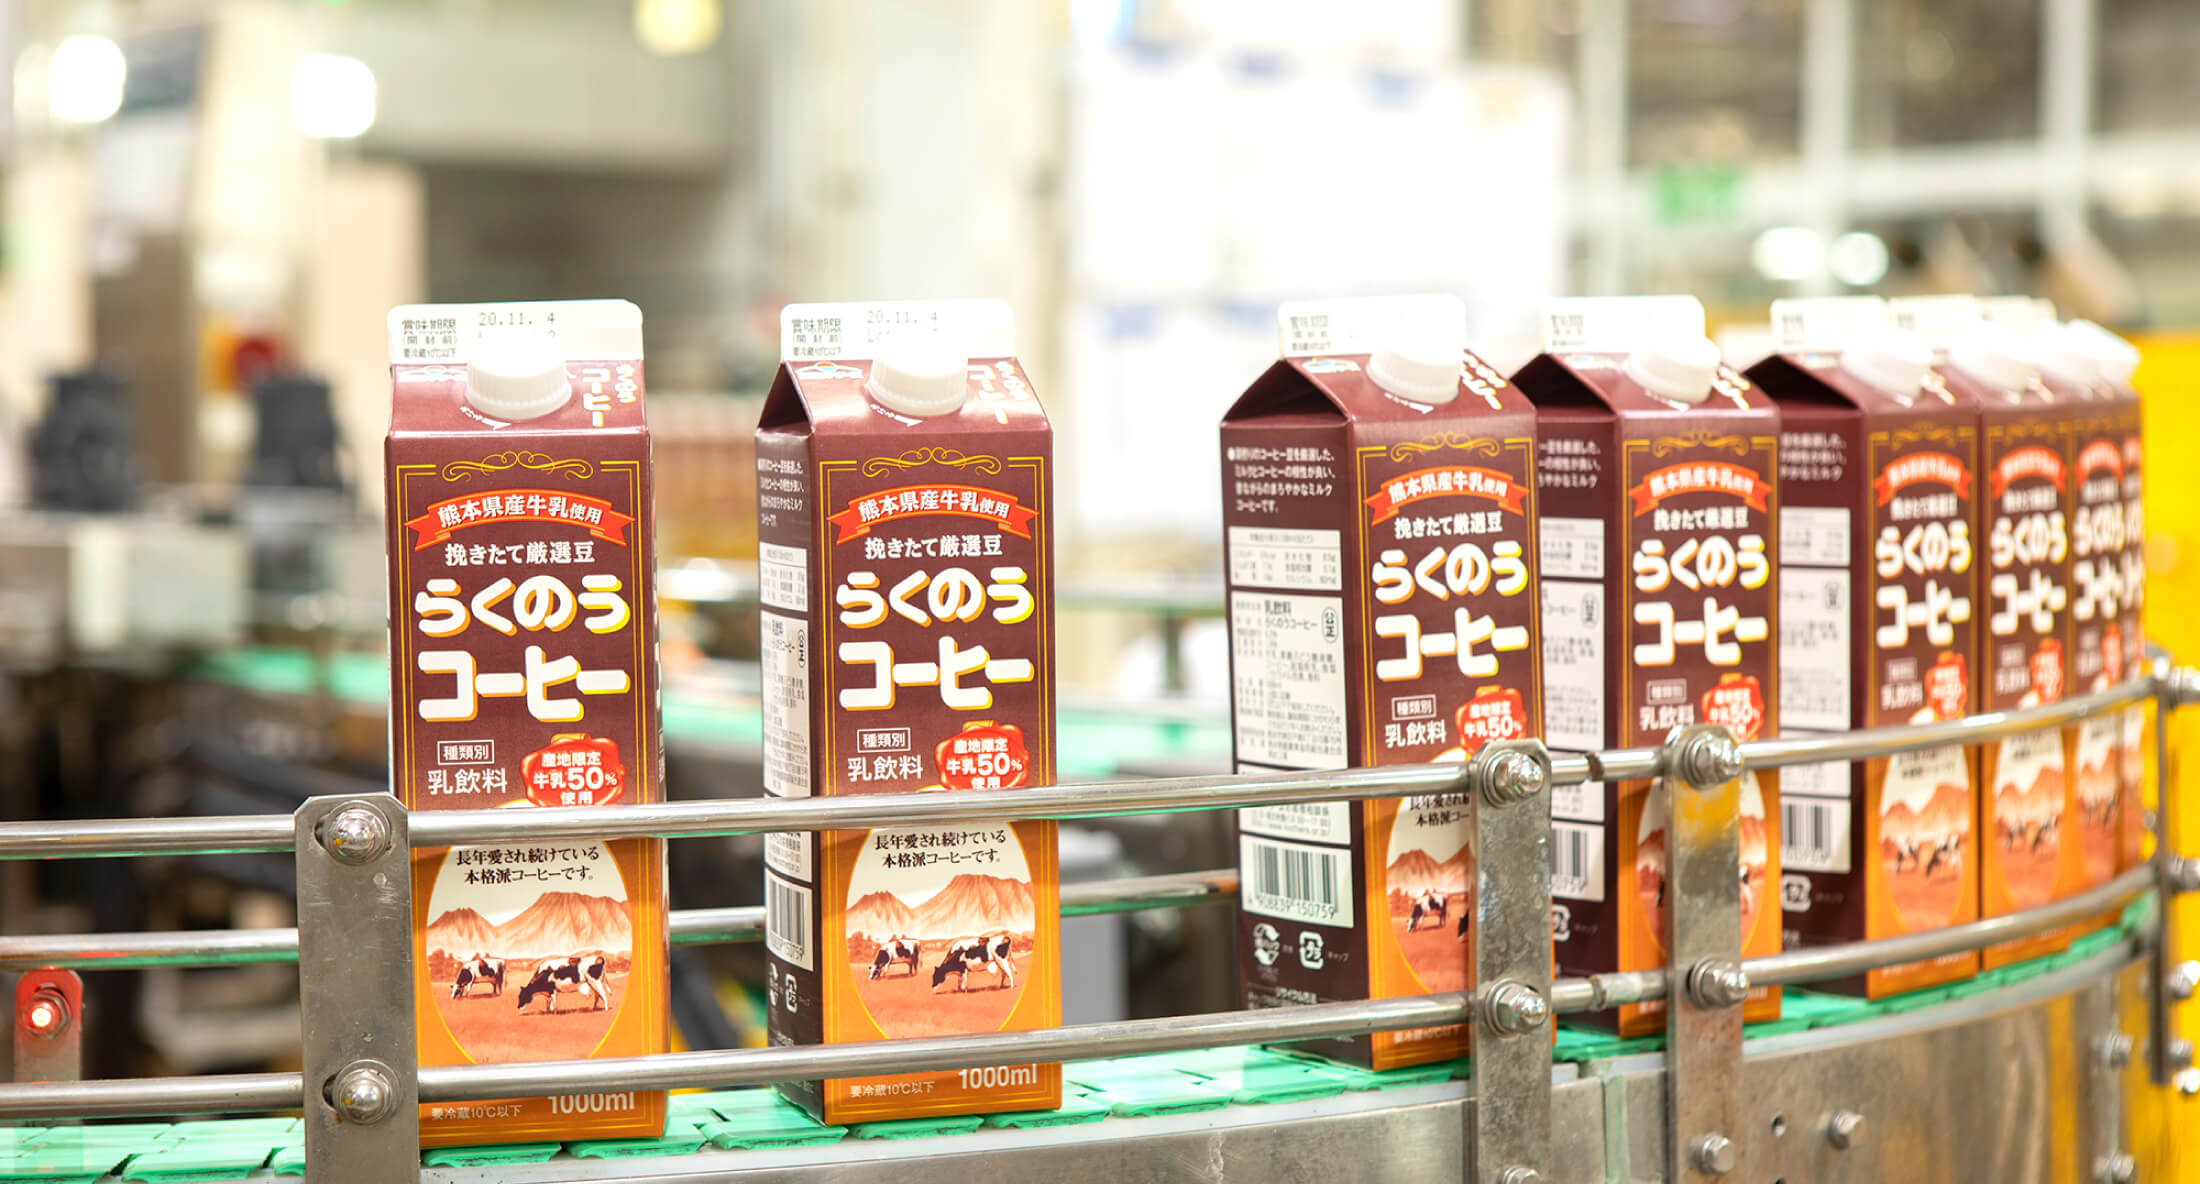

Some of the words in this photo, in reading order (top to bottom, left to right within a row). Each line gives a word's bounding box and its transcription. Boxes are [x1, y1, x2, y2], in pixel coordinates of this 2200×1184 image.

[479, 312, 532, 327] 20.11.
[547, 312, 556, 323] 4
[867, 310, 918, 324] 20.11.
[930, 311, 938, 322] 4
[582, 368, 611, 427] コーヒー
[1388, 471, 1507, 504] 熊本県産牛乳使用
[437, 495, 603, 528] 熊本県産牛乳使用
[858, 489, 1010, 522] 熊本県産牛乳使用
[1394, 510, 1503, 539] 挽きたて厳選豆
[865, 534, 1003, 560] 挽きたて厳選豆
[1875, 520, 1972, 578] らくのう
[1990, 511, 2067, 568] らくのう
[445, 541, 595, 567] 挽きたて厳選豆
[1633, 534, 1769, 592] らくのう
[1372, 540, 1528, 605] らくのう
[414, 574, 631, 637] らくのう
[836, 567, 1035, 628] らくのう
[1991, 568, 2067, 635] コーヒー
[1876, 579, 1971, 649] コーヒー
[1375, 607, 1529, 682] コーヒー
[1634, 596, 1768, 667] コーヒー
[418, 645, 631, 722] コーヒー
[838, 635, 1035, 711] コーヒー
[862, 732, 905, 748] 種類別
[954, 738, 1009, 754] 産地限定
[1385, 719, 1447, 749] 乳飲料
[442, 744, 490, 761] 種類別
[541, 751, 601, 767] 産地限定
[946, 753, 1023, 777] 牛乳50%
[427, 768, 508, 796] 乳飲料
[533, 766, 617, 791] 牛乳50%
[848, 755, 923, 782] 乳飲料
[560, 791, 593, 805] 使用
[875, 829, 1007, 851] 長年愛され続けている
[456, 846, 600, 866] 長年愛され続けている
[882, 848, 1001, 869] 本格派コーヒーです。
[464, 866, 594, 885] 本格派コーヒーです。
[850, 1081, 935, 1098] 要冷蔵10℃以下
[958, 1064, 1037, 1090] 1000ml
[431, 1104, 523, 1120] 要冷蔵10℃以下
[547, 1092, 635, 1114] 1000ml
